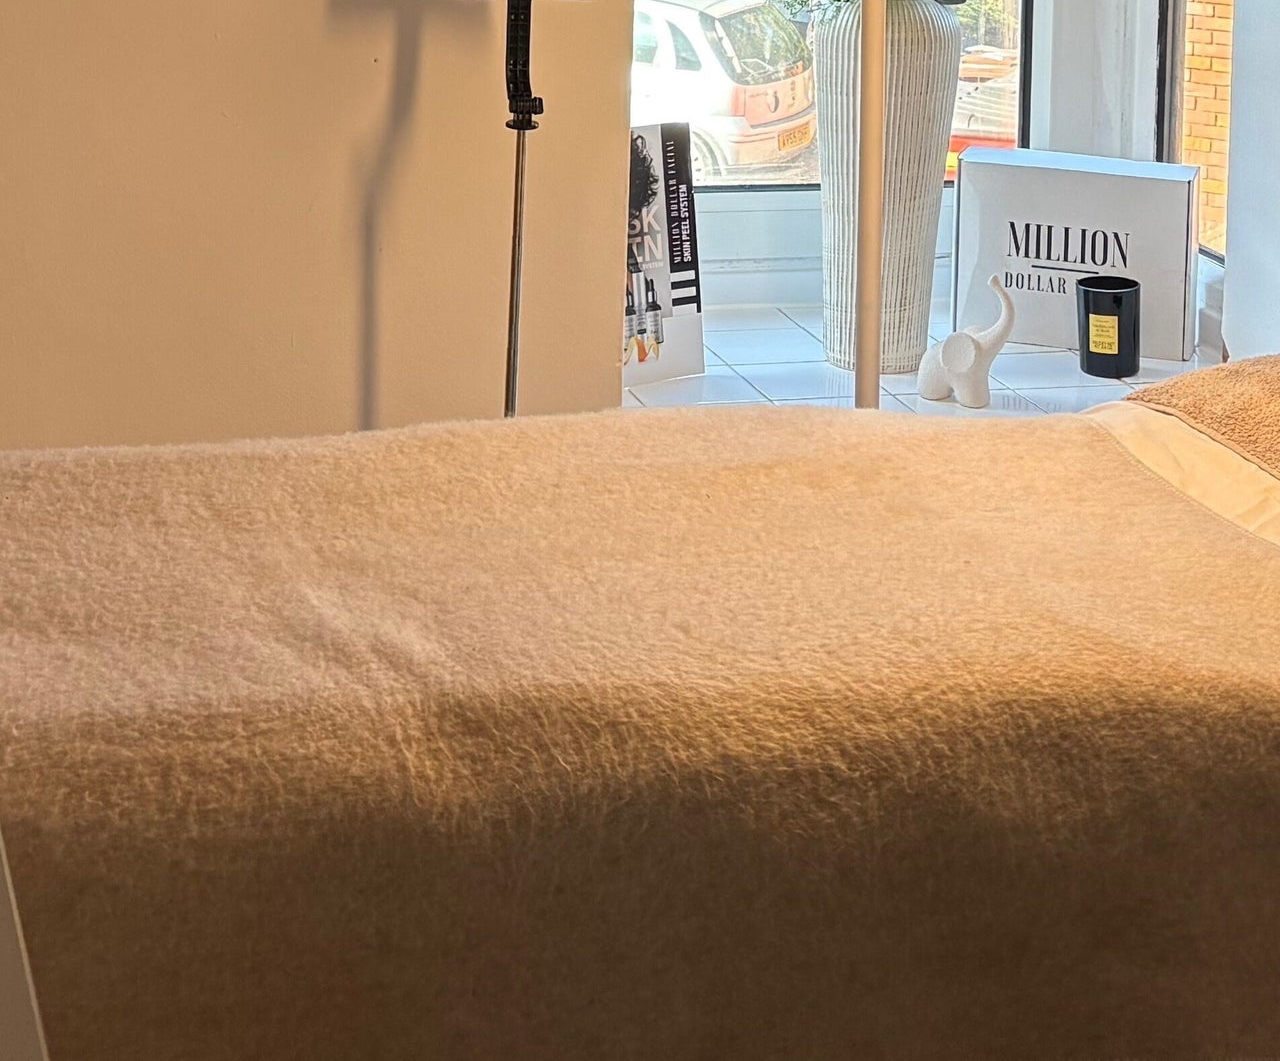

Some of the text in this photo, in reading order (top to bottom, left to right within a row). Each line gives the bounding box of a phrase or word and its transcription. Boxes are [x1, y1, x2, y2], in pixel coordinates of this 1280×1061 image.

[668, 179, 678, 217] DOLLAR
[671, 222, 681, 263] MILLION
[678, 184, 692, 262] SKIN PEEL SYSTEM
[1006, 221, 1130, 269] MILLION
[1005, 272, 1066, 294] DOLLAR
